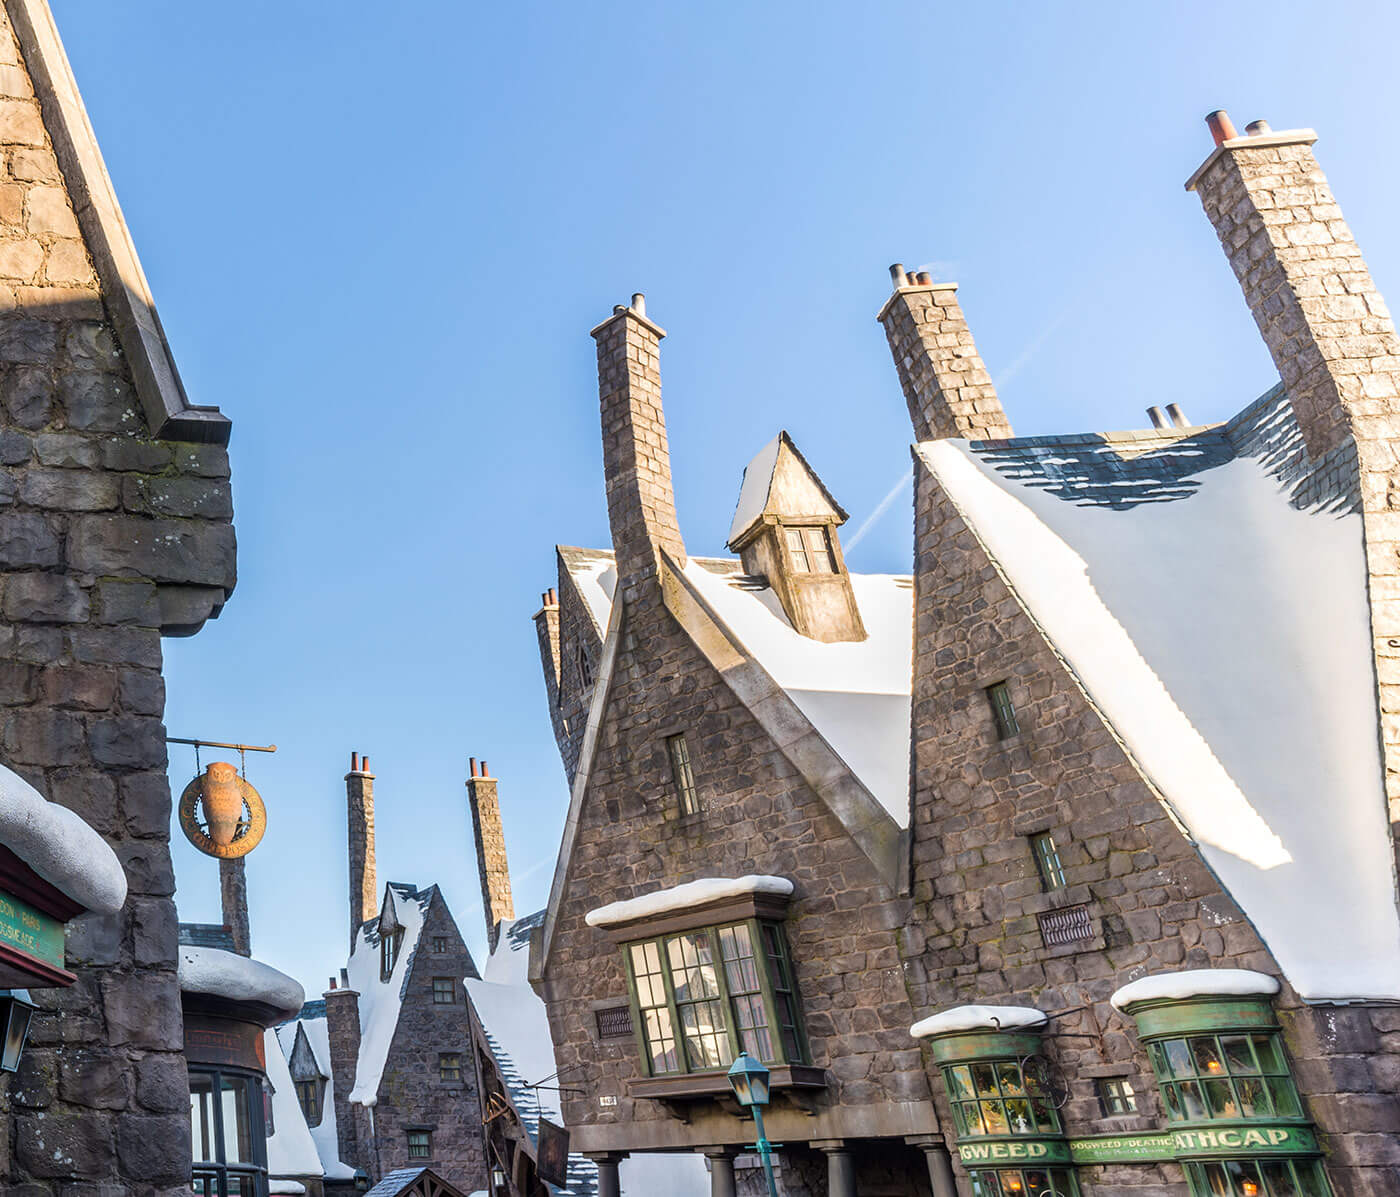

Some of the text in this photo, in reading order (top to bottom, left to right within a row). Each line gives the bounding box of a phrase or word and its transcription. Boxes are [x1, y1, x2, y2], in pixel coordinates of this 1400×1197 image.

[1070, 1141, 1121, 1150] DOGWEED
[1128, 1138, 1172, 1147] DEATHC
[1174, 1129, 1289, 1149] ATHCAP
[959, 1143, 1047, 1160] GWEED
